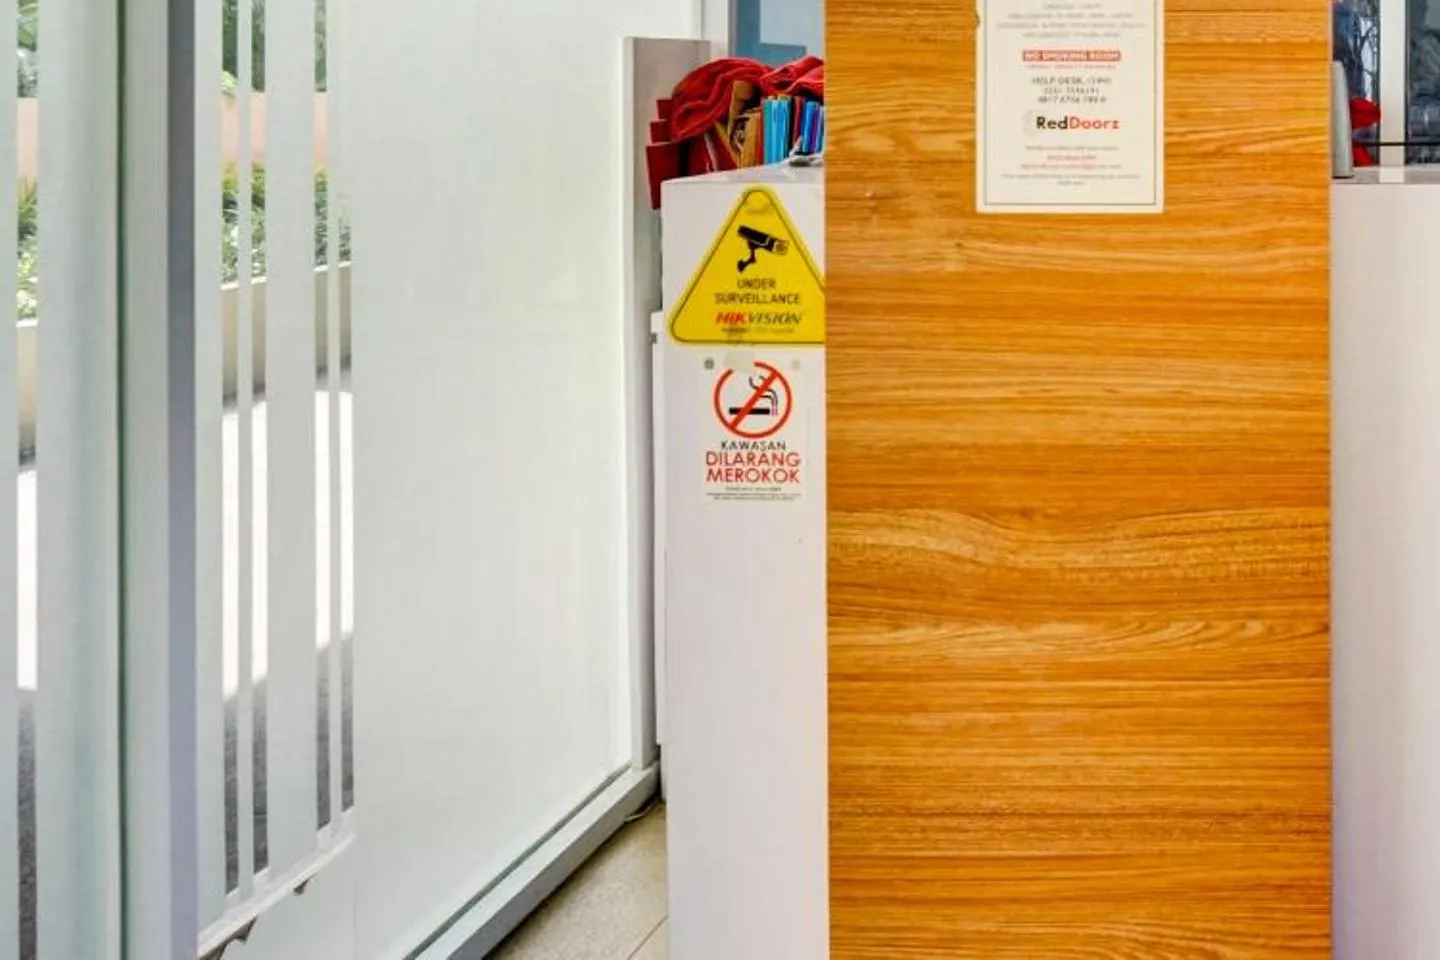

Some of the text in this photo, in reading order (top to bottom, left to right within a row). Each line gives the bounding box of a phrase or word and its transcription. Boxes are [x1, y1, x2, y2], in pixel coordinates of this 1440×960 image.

[1036, 116, 1121, 130] RedDoorz
[737, 278, 776, 289] UNDER
[714, 292, 801, 304] SURVEILLANCE
[715, 311, 802, 325] HIKVISION
[721, 441, 786, 451] KAWASAN
[706, 451, 801, 467] DILARANG
[706, 468, 800, 483] MEROKOK
